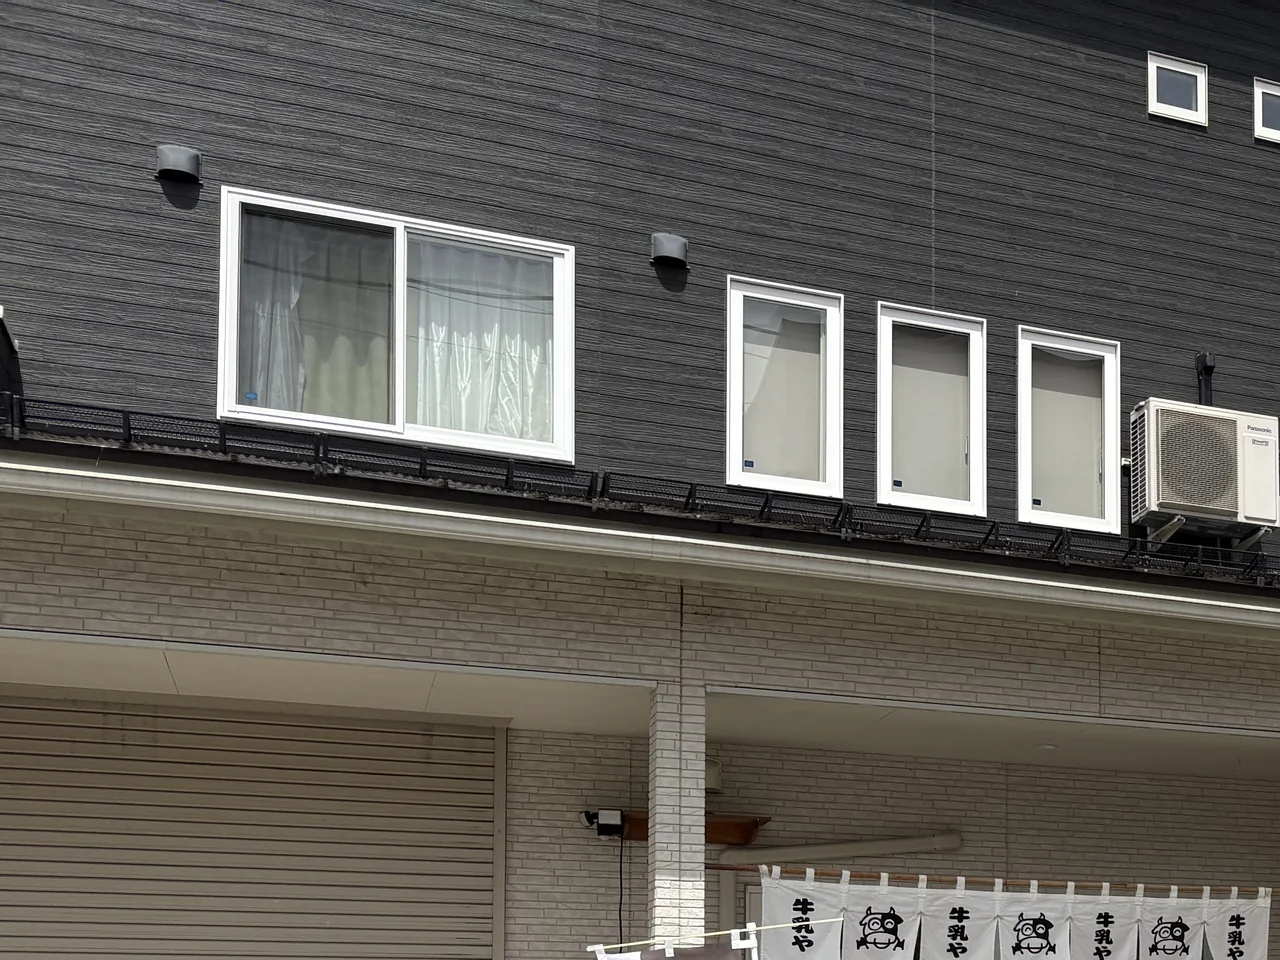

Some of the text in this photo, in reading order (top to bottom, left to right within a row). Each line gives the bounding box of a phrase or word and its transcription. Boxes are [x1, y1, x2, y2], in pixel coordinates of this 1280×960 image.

[1247, 425, 1272, 433] Panasonic
[791, 898, 816, 952] 牛乳や
[947, 907, 970, 958] 牛乳や
[1093, 912, 1115, 960] 牛乳や
